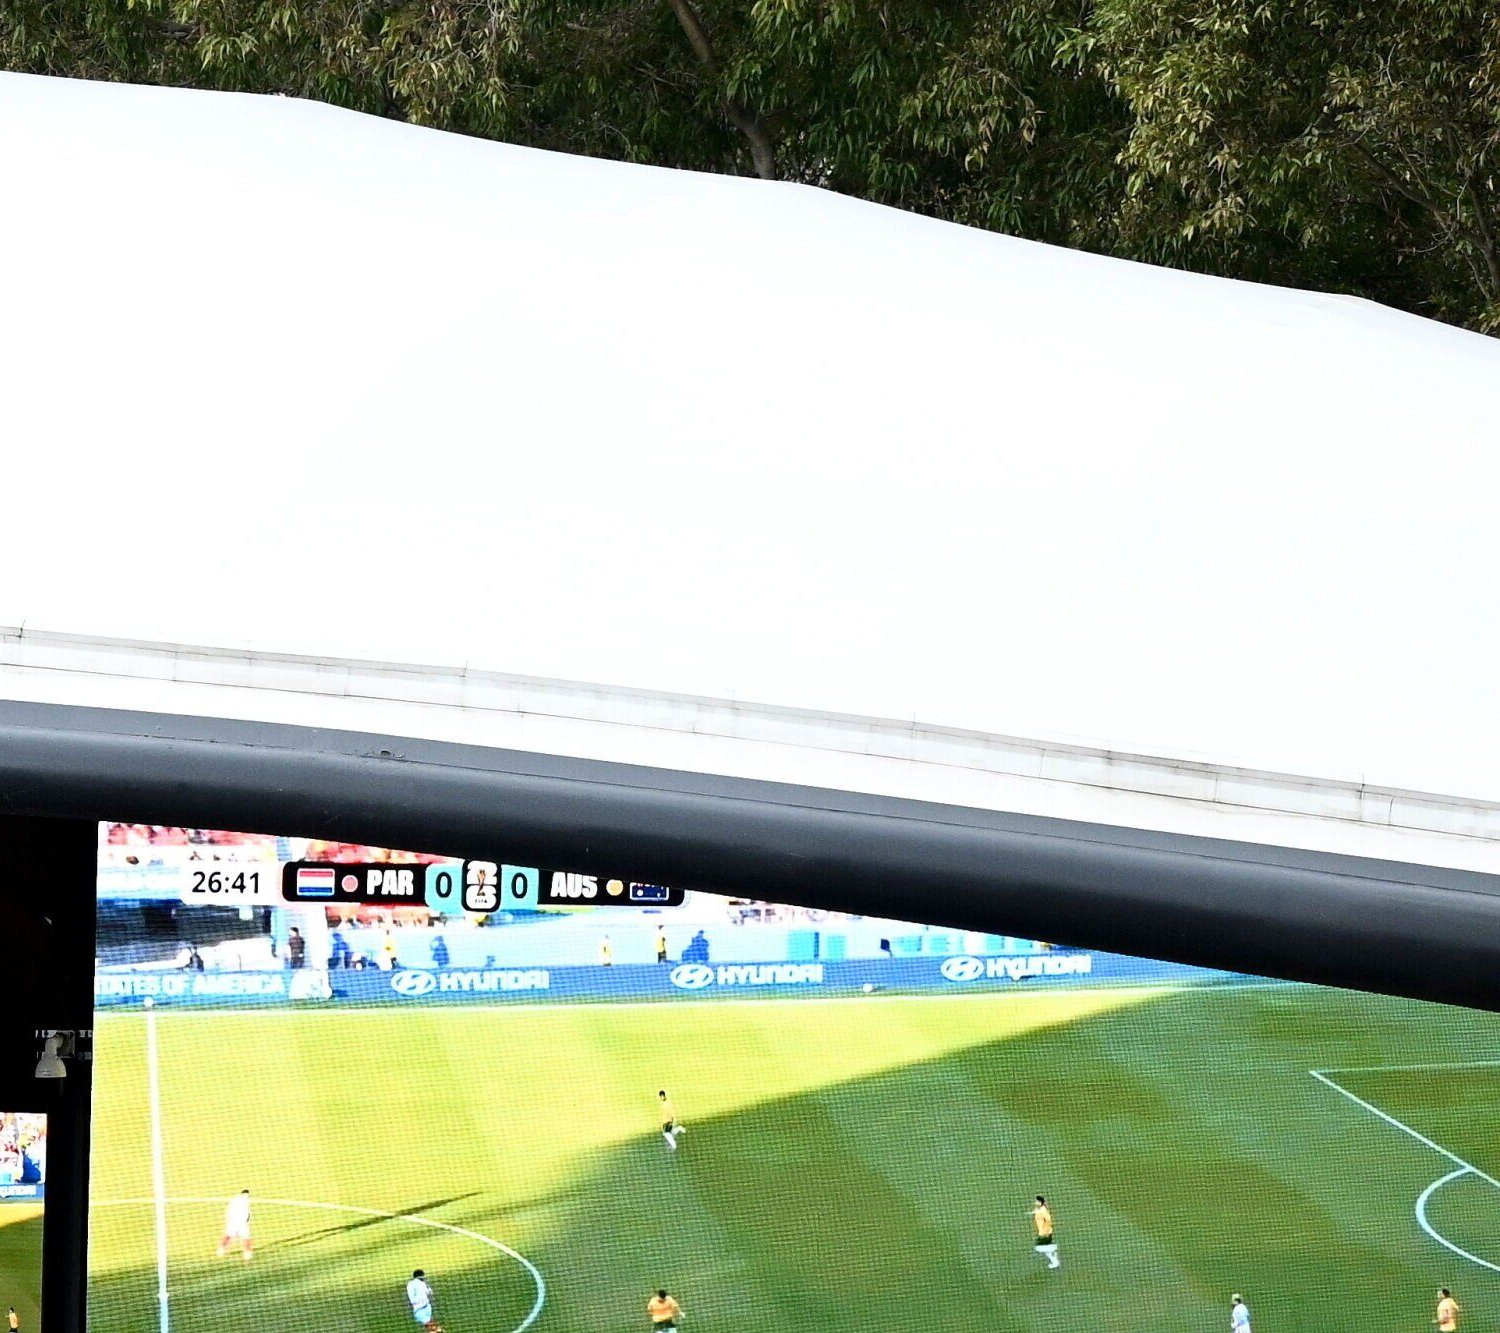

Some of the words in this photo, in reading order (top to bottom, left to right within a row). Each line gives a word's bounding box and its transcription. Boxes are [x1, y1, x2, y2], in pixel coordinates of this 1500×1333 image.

[191, 871, 260, 894] 26:41
[367, 869, 414, 896] PAR
[435, 871, 452, 898] 0
[511, 872, 528, 899] 0
[550, 872, 598, 898] AUS
[716, 963, 824, 984] HYUNDAI
[986, 954, 1092, 979] HYUNDAI
[192, 974, 285, 995] AMERICA
[440, 970, 550, 991] HYUNDAI
